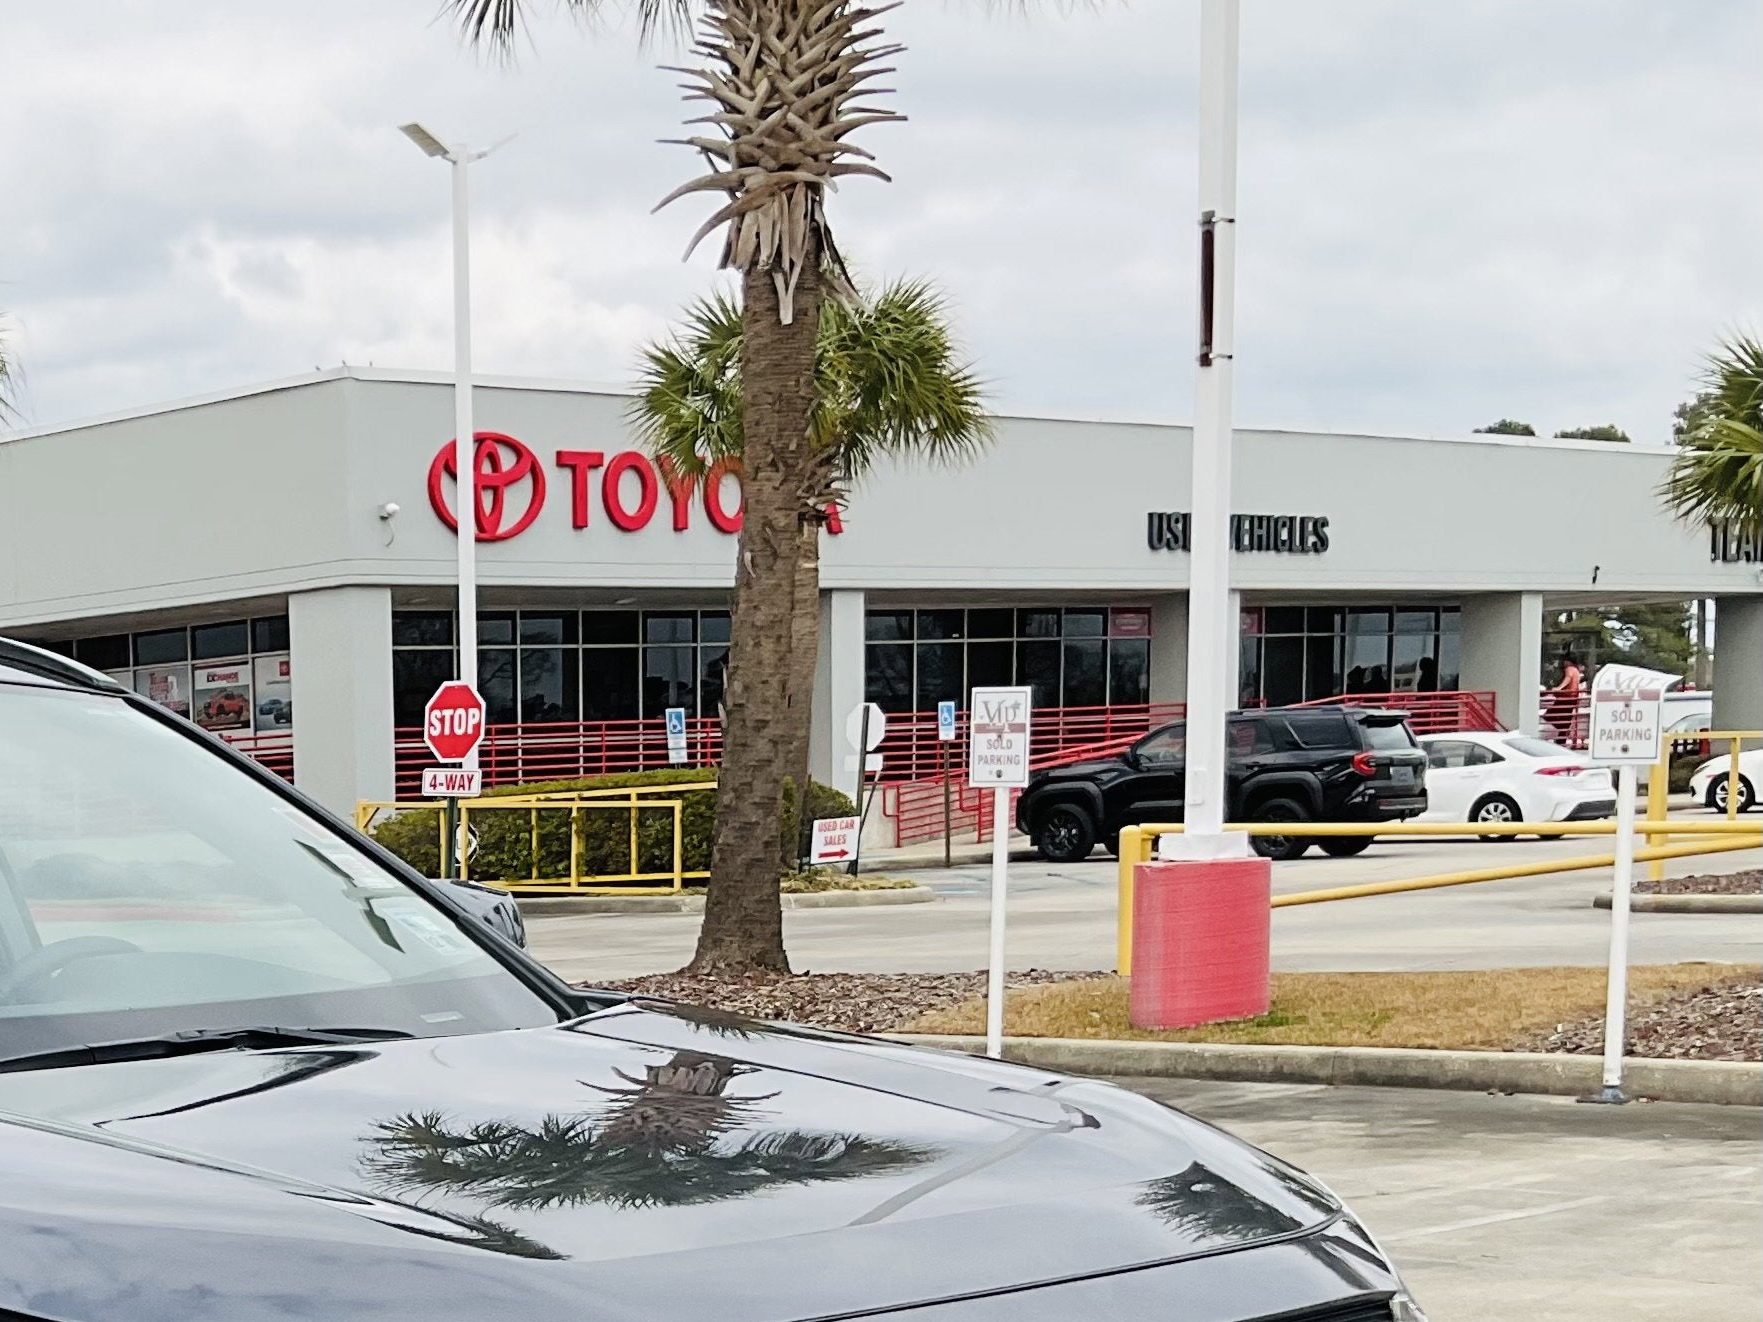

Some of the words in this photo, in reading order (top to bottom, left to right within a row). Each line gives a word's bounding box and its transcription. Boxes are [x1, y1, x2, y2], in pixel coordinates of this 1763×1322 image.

[556, 450, 843, 534] TOYO
[1147, 512, 1191, 552] US
[1707, 517, 1763, 563] TEA
[429, 707, 480, 736] STOP
[1611, 710, 1643, 723] SOLD
[1599, 728, 1652, 741] PARKING
[986, 739, 1013, 750] SOLD
[977, 754, 1021, 766] PARKING
[429, 773, 474, 791] 4-WAY
[818, 821, 837, 832] USED
[838, 819, 854, 831] CAR
[823, 834, 847, 846] SALES
